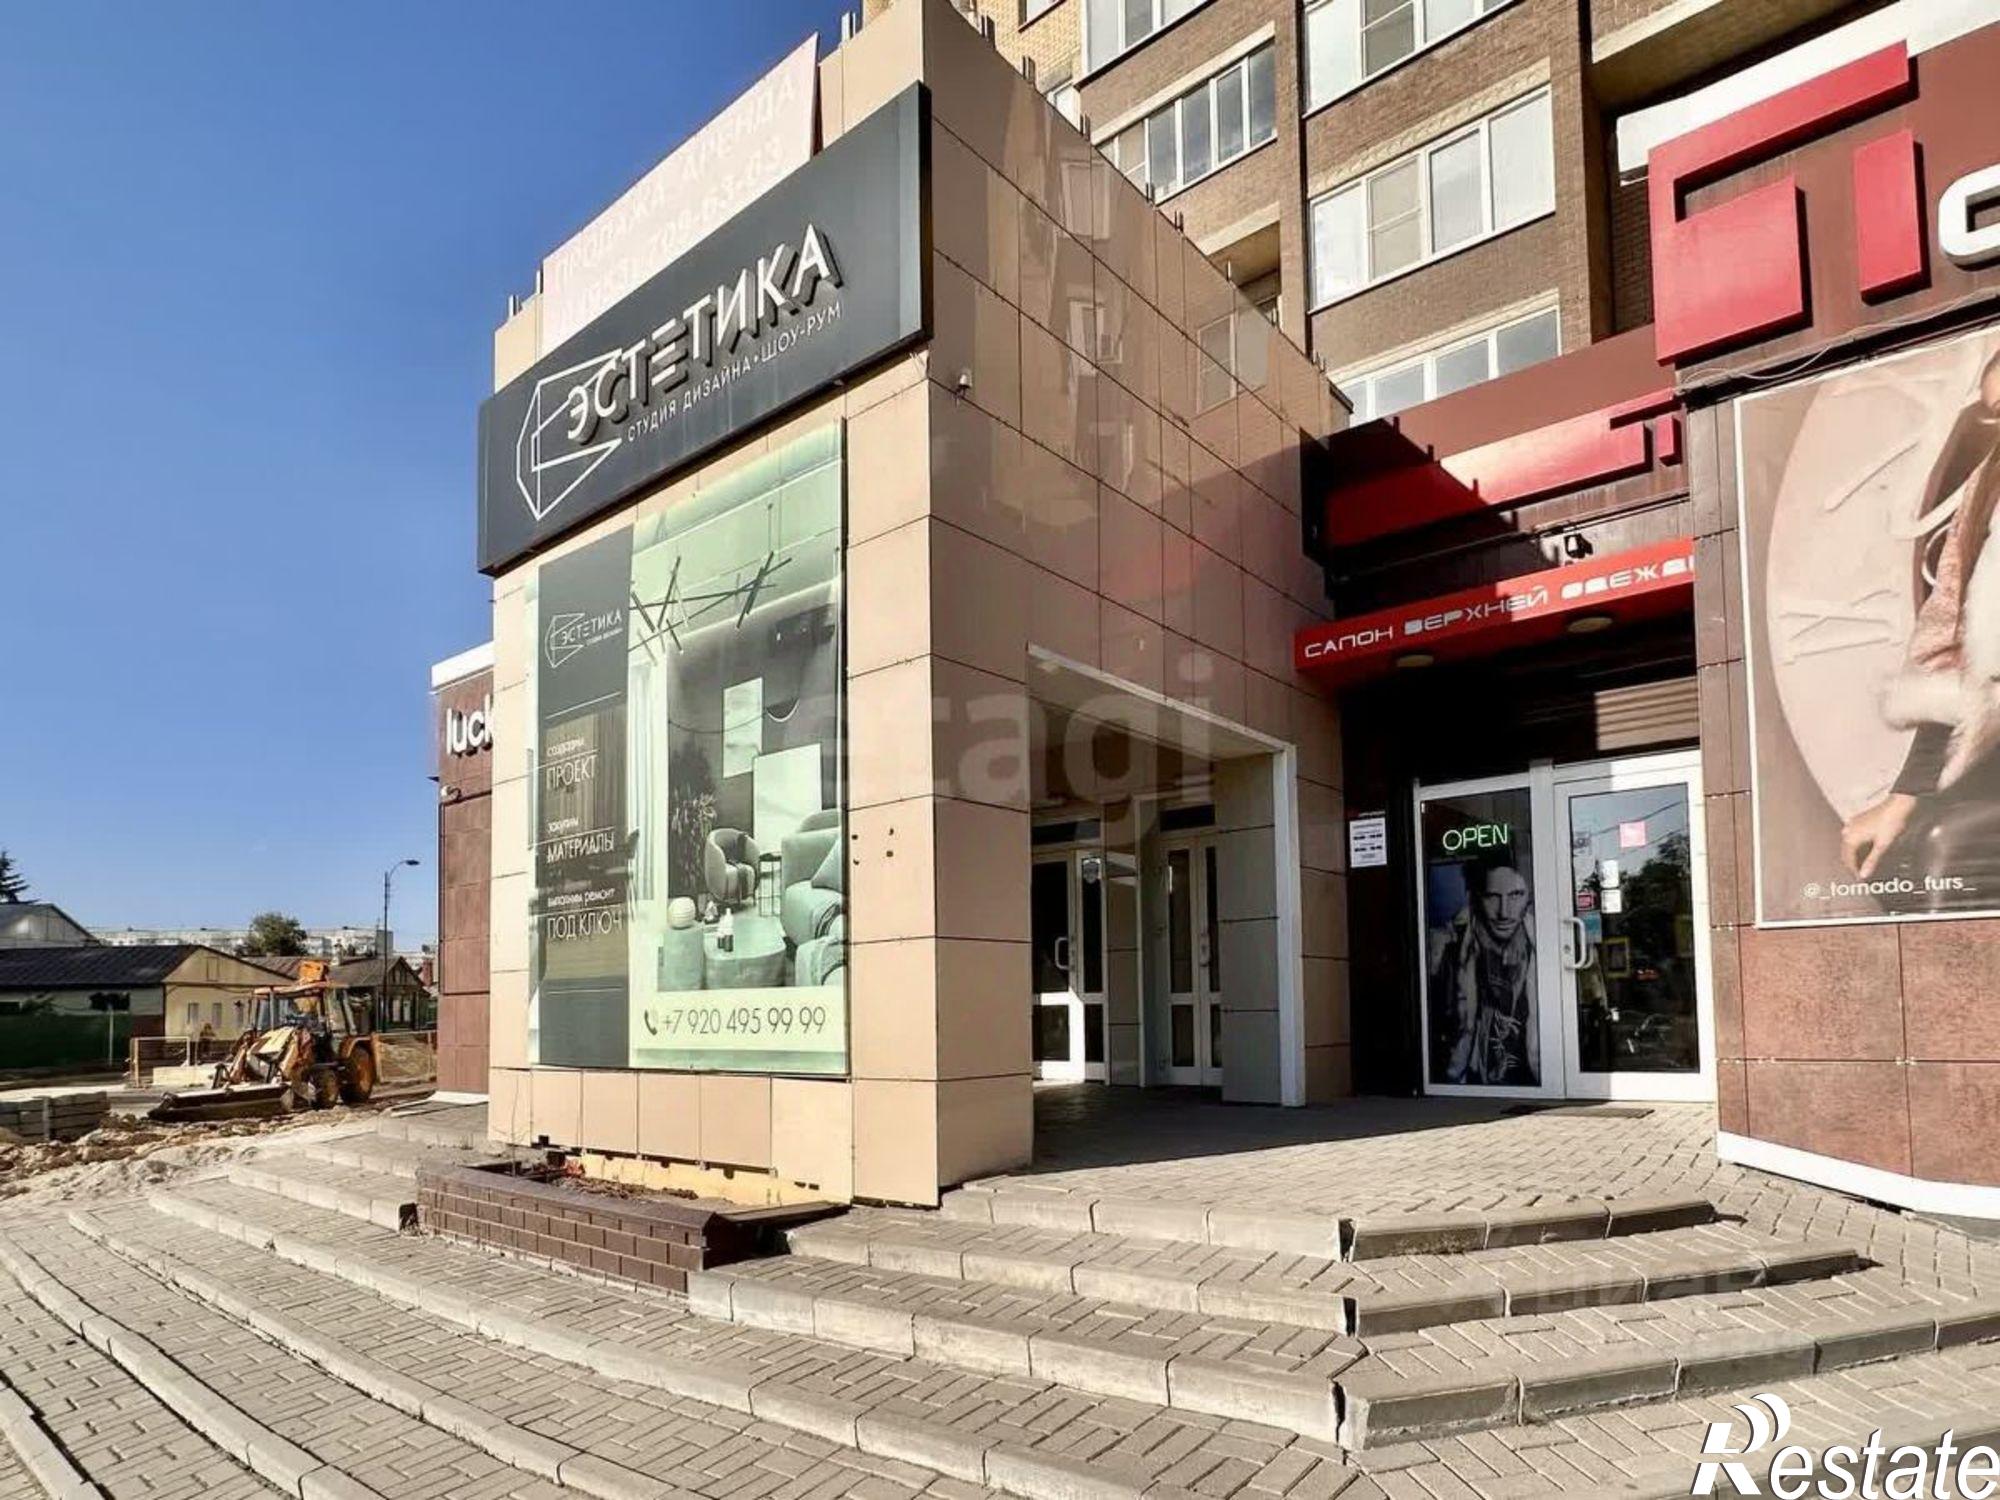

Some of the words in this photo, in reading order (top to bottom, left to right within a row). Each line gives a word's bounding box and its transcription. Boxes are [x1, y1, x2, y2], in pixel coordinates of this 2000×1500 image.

[567, 223, 838, 443] ЭСТЕТИКА
[627, 400, 677, 442] СТУДИЯ
[1304, 625, 1394, 659] САЛОН
[1403, 584, 1549, 636] ВЕРХНЕЙ
[1560, 553, 1695, 600] ОДЕЖД
[561, 607, 623, 646] ЭСТЕТИКА
[546, 755, 598, 790] ПРОЕКТ
[547, 832, 615, 864] МАТЕРИАЛЫ
[1442, 823, 1508, 851] OPEN
[547, 914, 578, 941] ПОД
[580, 910, 625, 938] КЛЮЧ
[662, 1008, 684, 1034] +7
[687, 1008, 722, 1035] 920
[726, 1007, 762, 1035] 495
[767, 1006, 794, 1035] 99
[799, 1005, 827, 1035] 99
